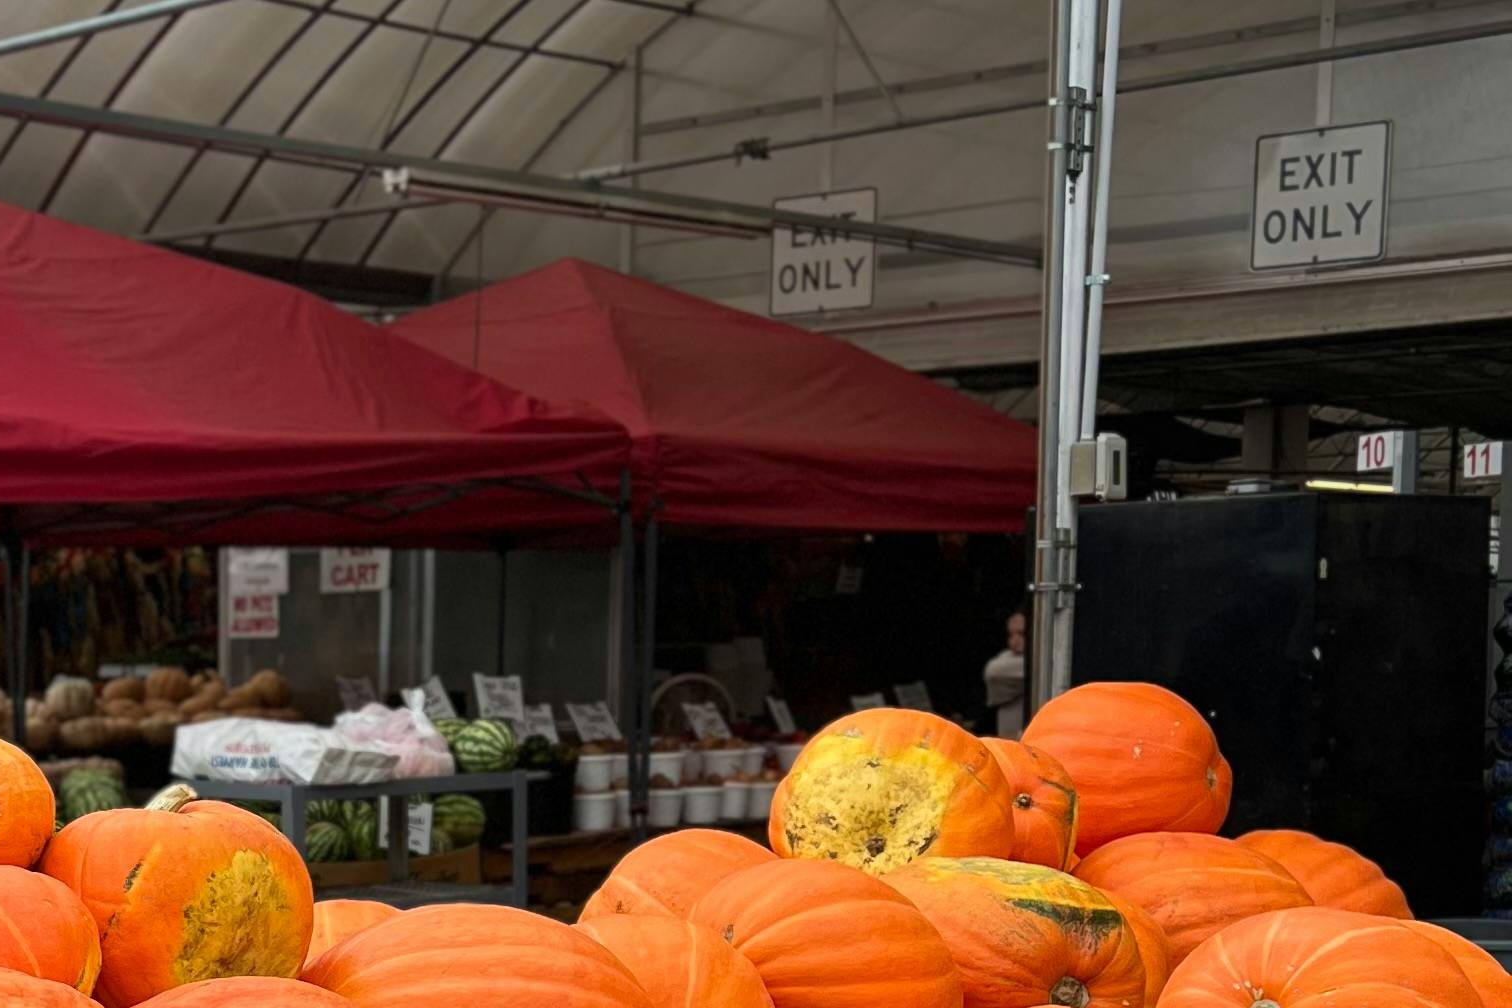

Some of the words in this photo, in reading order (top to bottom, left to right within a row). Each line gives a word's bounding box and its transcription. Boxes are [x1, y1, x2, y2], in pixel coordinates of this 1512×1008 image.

[1279, 149, 1362, 192] EXIT
[1263, 200, 1373, 244] ONLY
[779, 256, 865, 294] ONLY
[1362, 435, 1386, 468] 10
[1466, 443, 1491, 476] 11
[331, 563, 379, 588] CART
